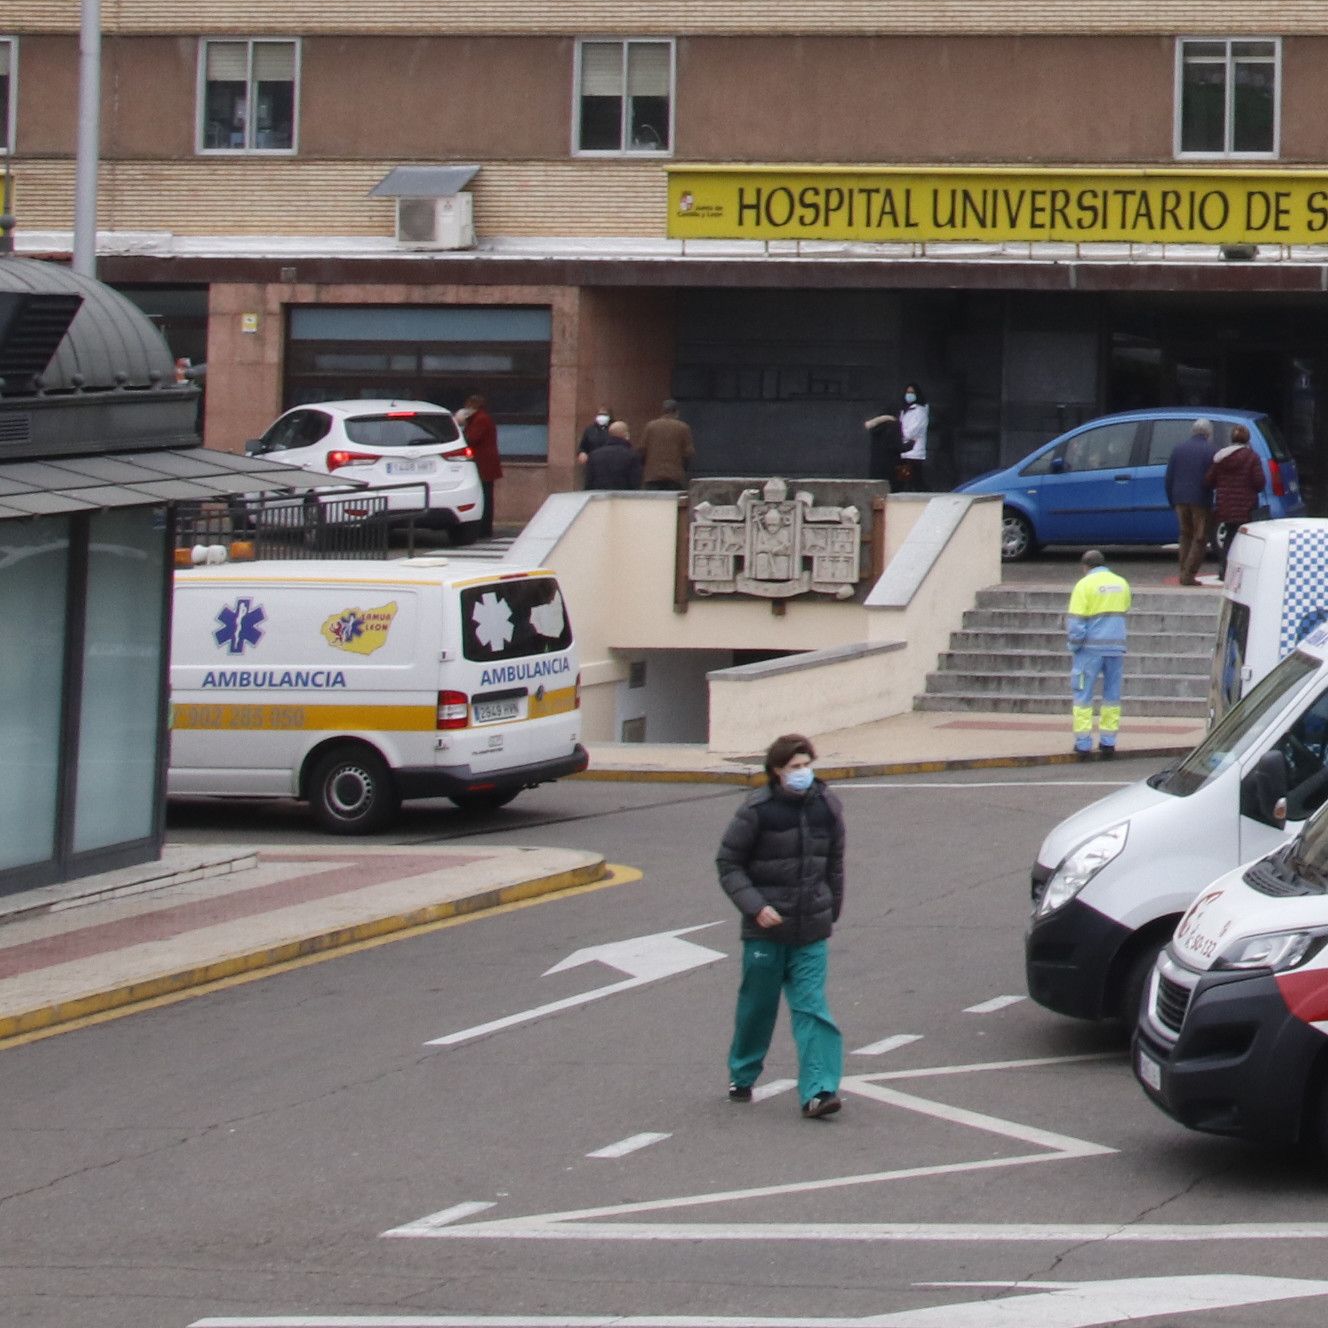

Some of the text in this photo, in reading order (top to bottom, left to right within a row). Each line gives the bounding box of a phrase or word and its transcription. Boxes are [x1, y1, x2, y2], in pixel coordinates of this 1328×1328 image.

[738, 187, 918, 228] HOSPITAL
[932, 188, 1230, 232] UNIVERSITARIO
[1246, 191, 1291, 231] DE
[202, 671, 346, 687] AMBULANCIA
[480, 657, 570, 686] AMBULANCIA
